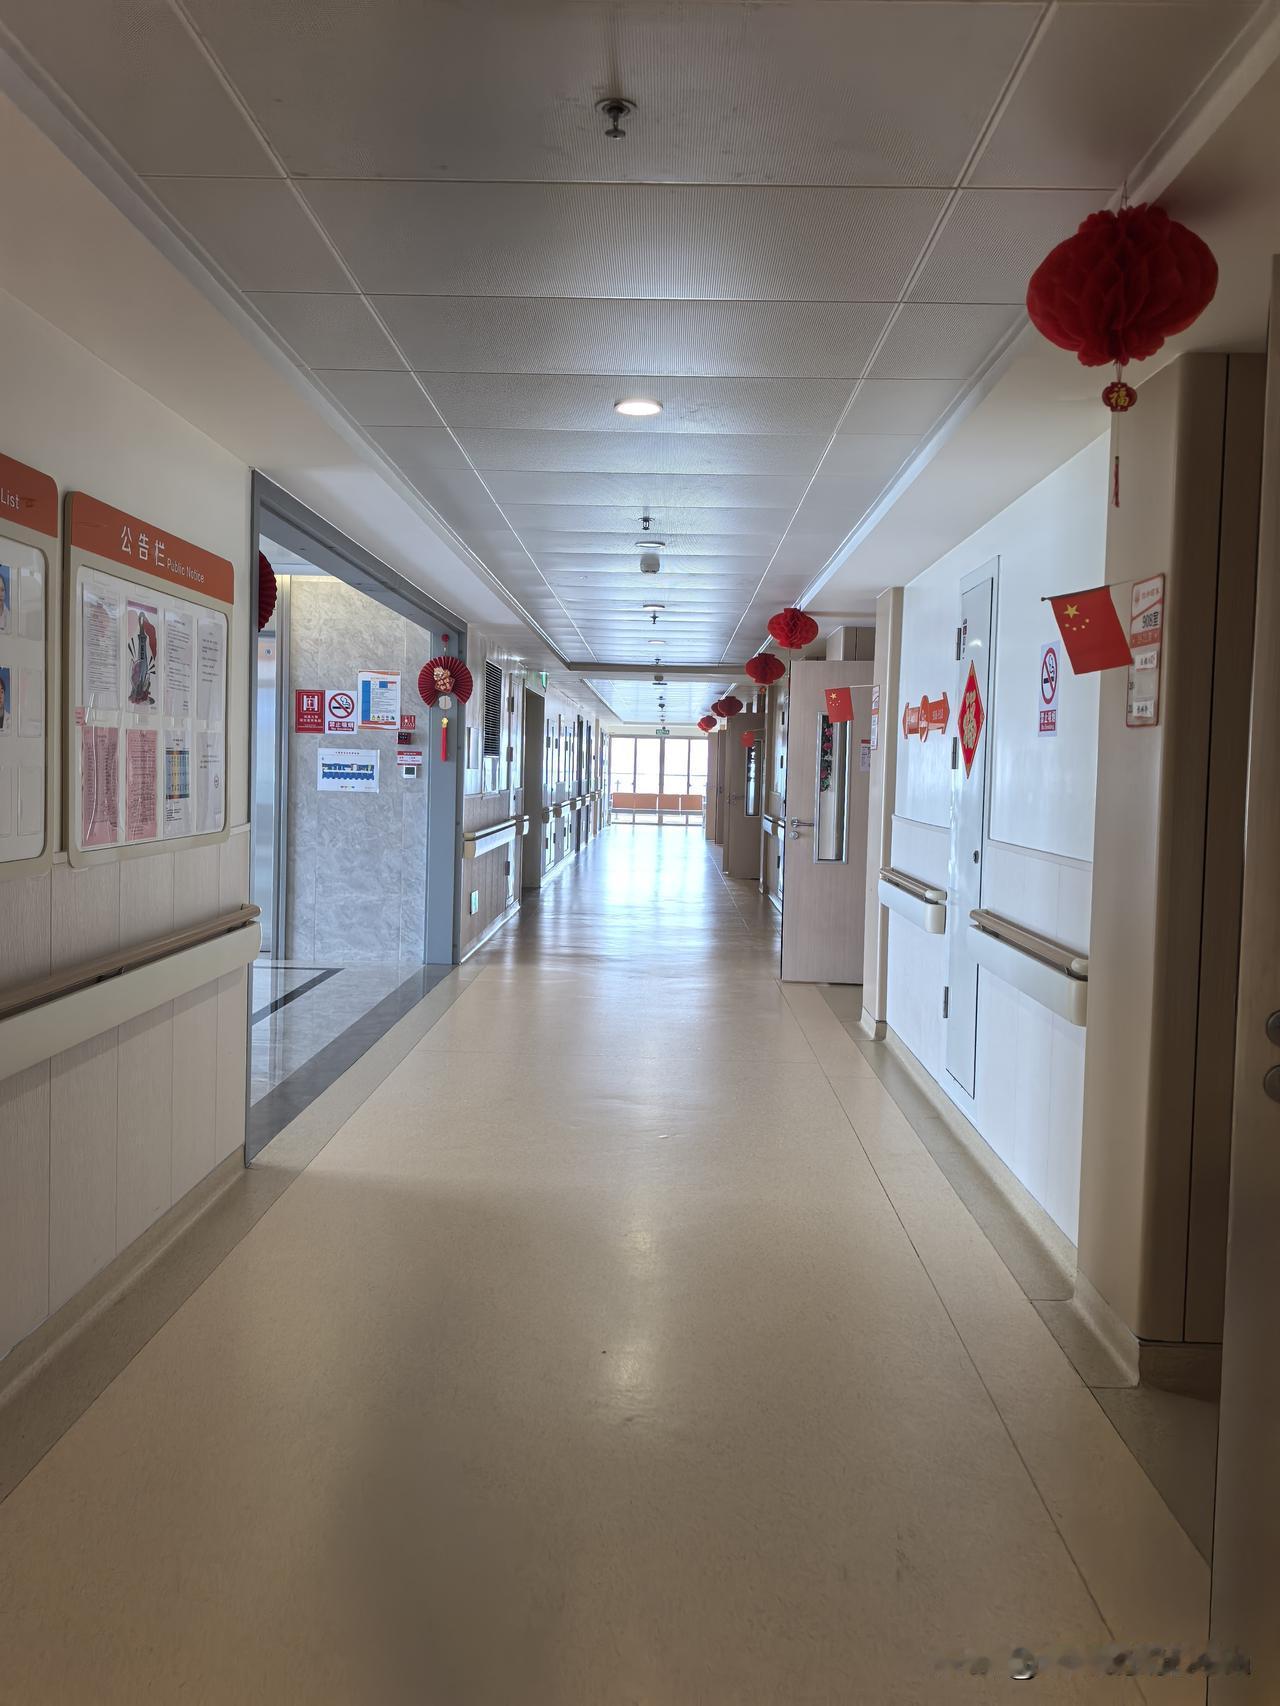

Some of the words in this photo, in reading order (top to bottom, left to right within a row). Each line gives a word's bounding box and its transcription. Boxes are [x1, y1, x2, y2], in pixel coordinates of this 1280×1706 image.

[0, 488, 20, 510] List
[121, 525, 165, 567] 公告栏
[167, 558, 185, 576] Public
[186, 566, 205, 583] Notice
[1041, 711, 1056, 723] 禁止吸烟
